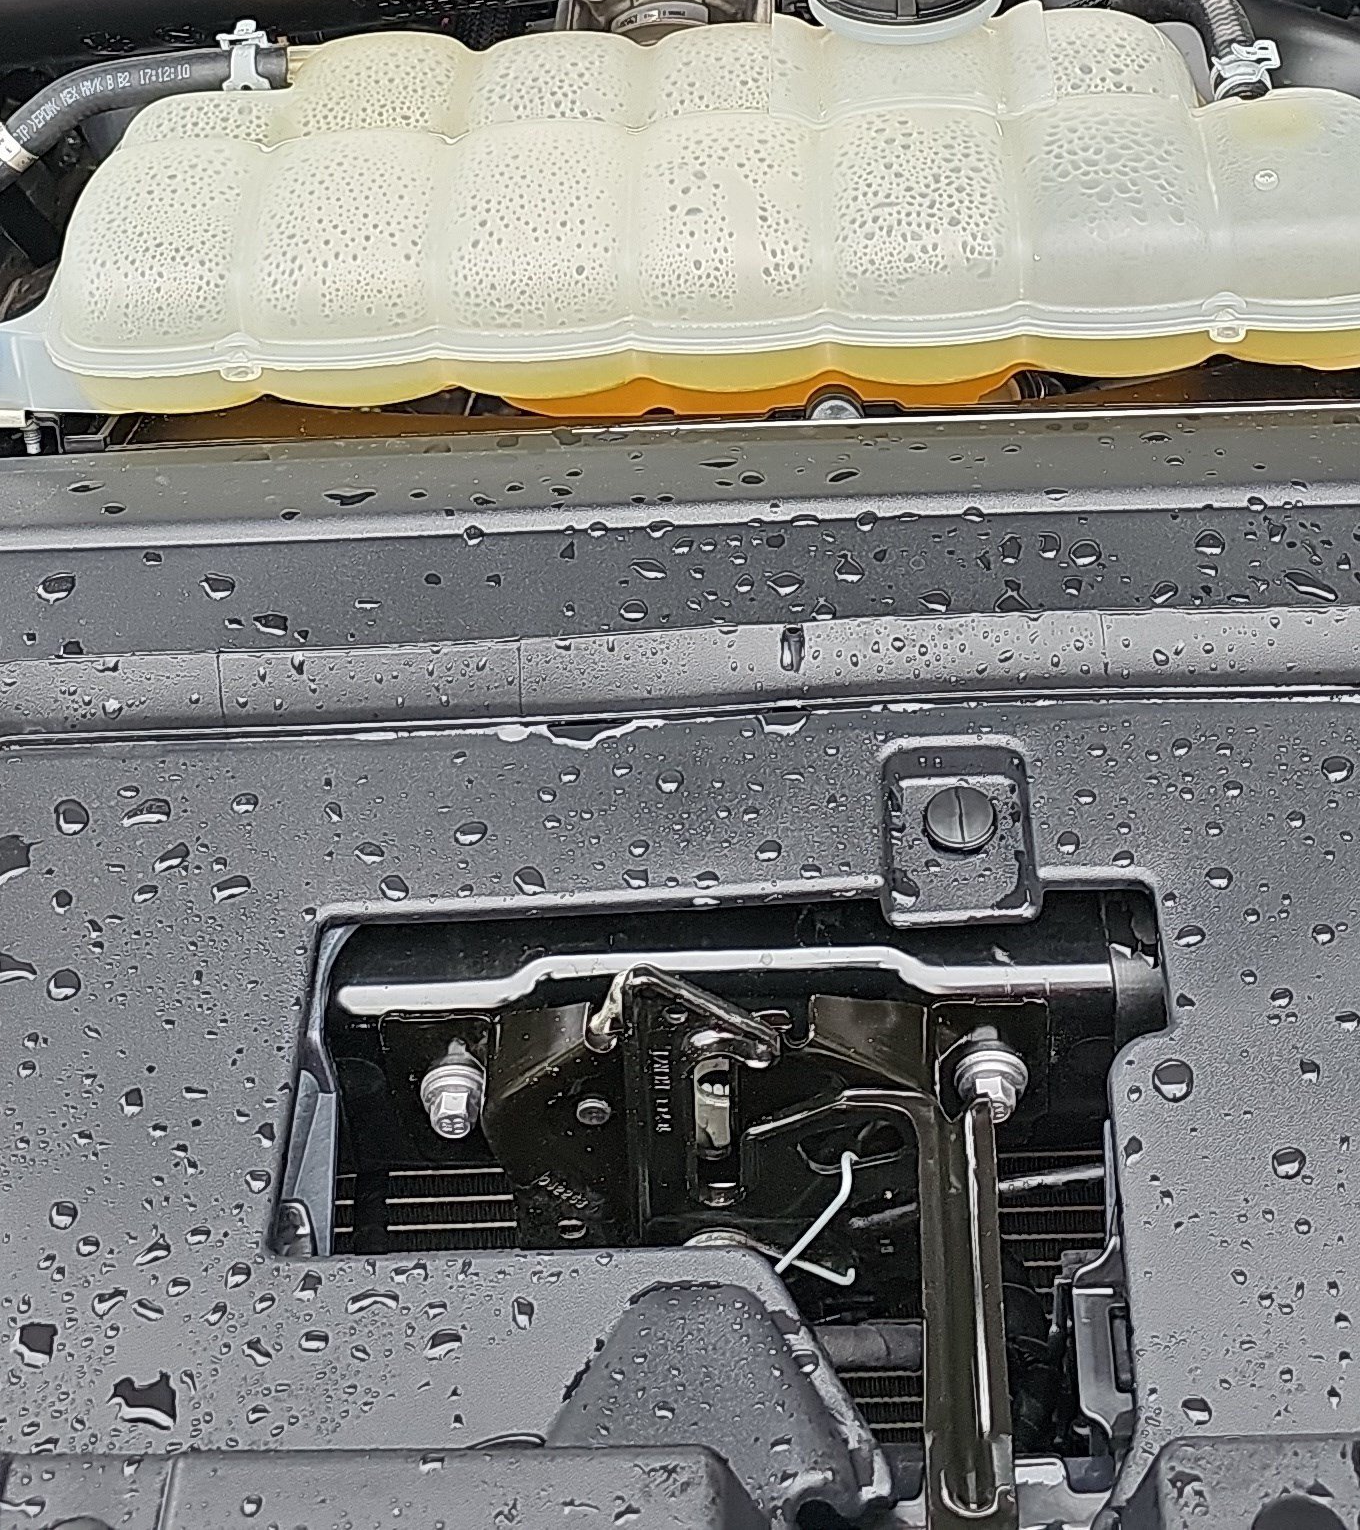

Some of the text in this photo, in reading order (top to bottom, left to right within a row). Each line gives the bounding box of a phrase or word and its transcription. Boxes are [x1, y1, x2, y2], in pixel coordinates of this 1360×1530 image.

[106, 74, 115, 91] B
[117, 72, 131, 89] B2
[139, 64, 191, 85] 17:12:10
